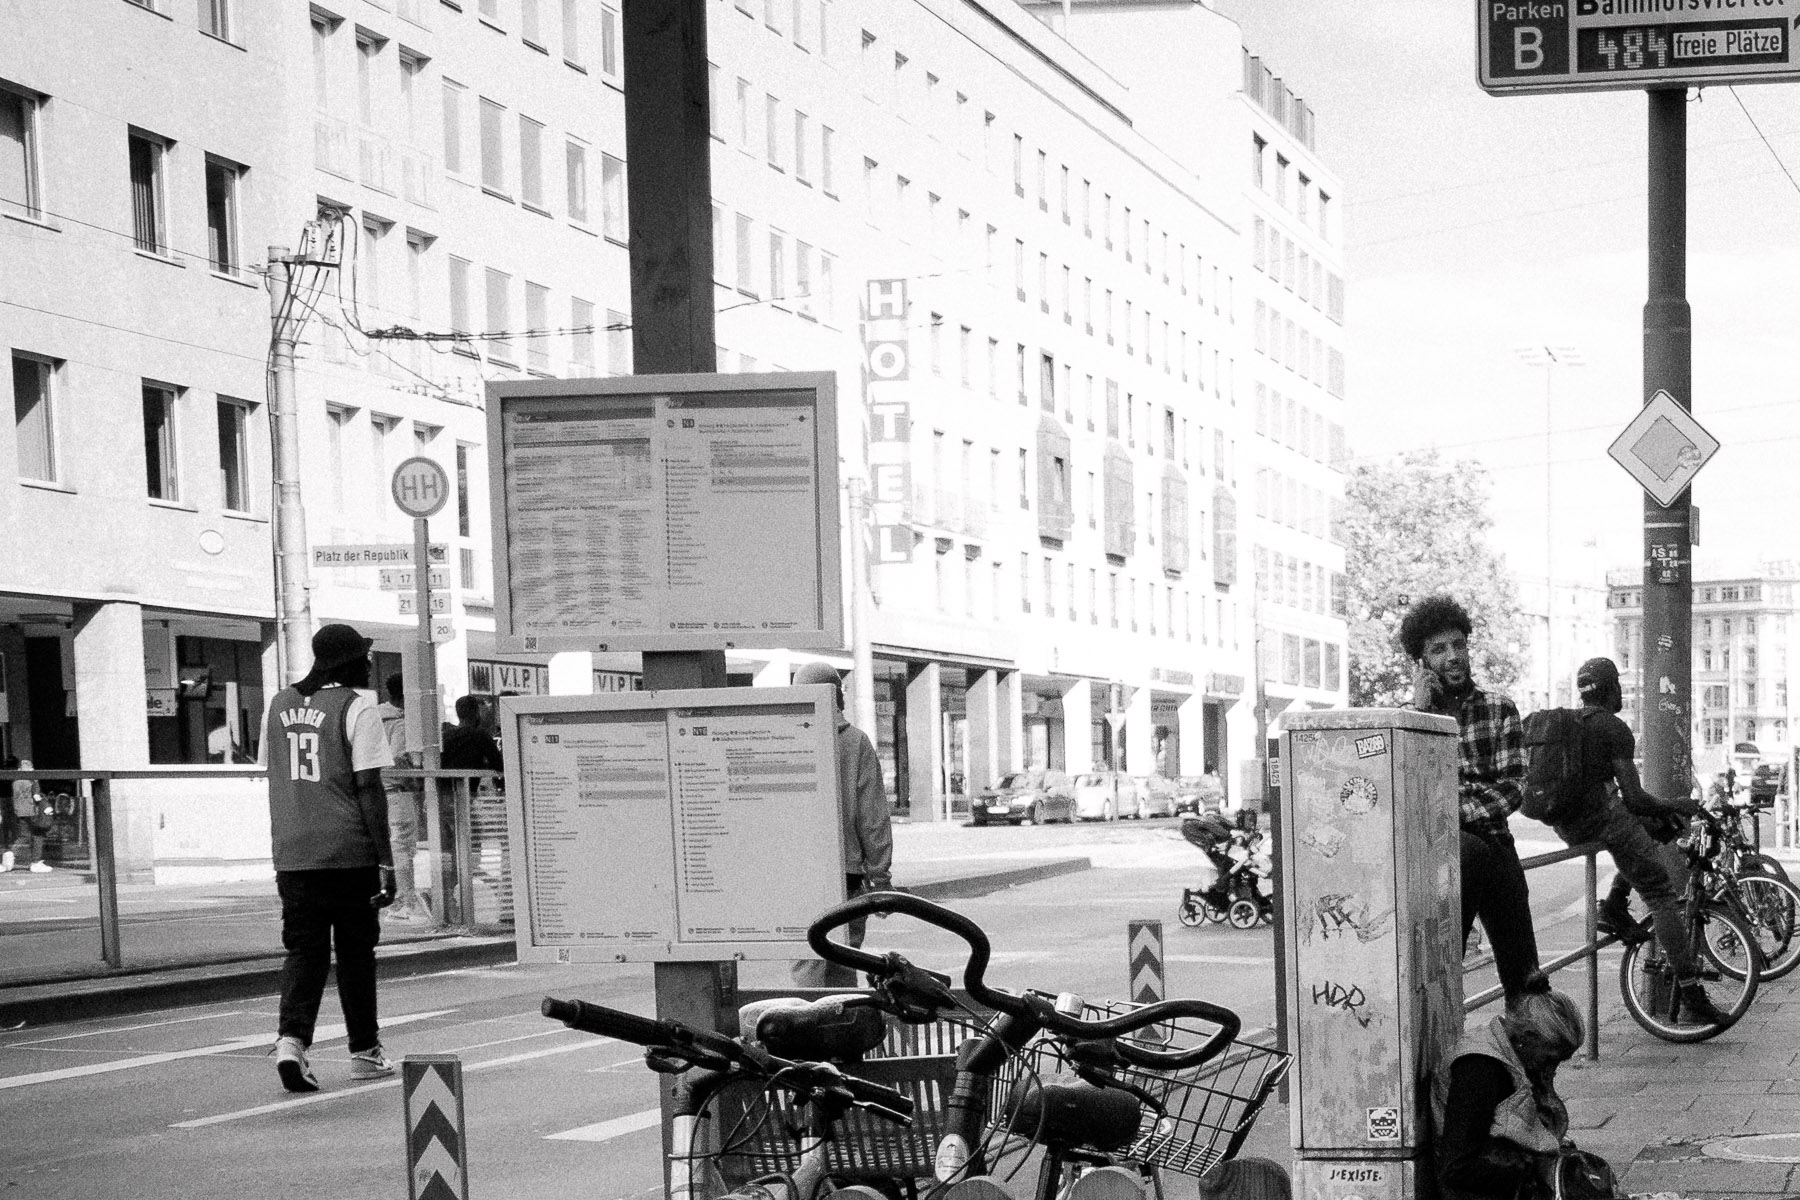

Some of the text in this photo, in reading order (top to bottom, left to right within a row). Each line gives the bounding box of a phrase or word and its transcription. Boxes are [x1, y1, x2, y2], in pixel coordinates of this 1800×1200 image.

[1493, 2, 1564, 21] Parken
[1514, 27, 1544, 70] B
[1598, 29, 1668, 69] 484
[1676, 31, 1780, 56] freie Plätze
[868, 280, 908, 563] HOTEL
[316, 549, 409, 562] Platz der Republik
[400, 574, 411, 583] 17
[432, 574, 443, 583] 11
[400, 600, 411, 608] 21
[437, 625, 448, 635] 20
[500, 667, 531, 688] V.I.P.
[280, 707, 326, 728] HARDEN
[286, 731, 320, 782] 13
[1330, 1169, 1382, 1182] J'EXISTE.
